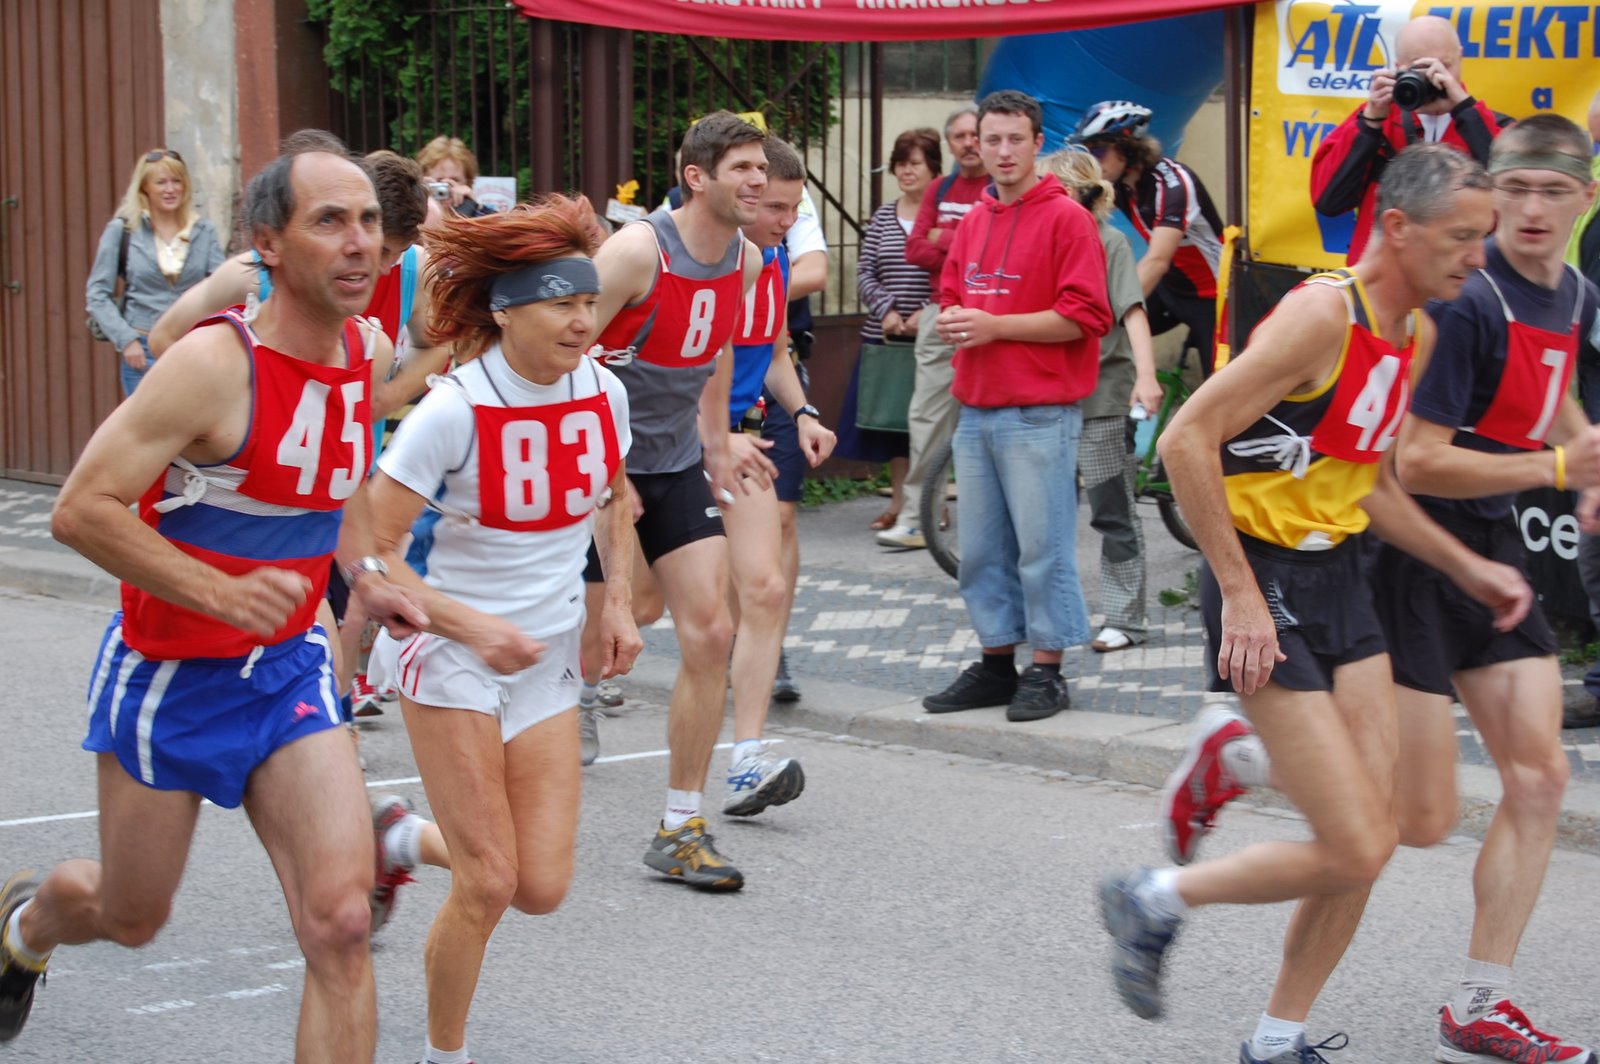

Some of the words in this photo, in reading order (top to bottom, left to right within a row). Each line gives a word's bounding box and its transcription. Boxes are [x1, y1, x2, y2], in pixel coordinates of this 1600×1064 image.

[1285, 5, 1385, 71] ATL
[1428, 6, 1600, 58] LEKT
[1531, 87, 1553, 109] a
[680, 288, 716, 358] 8
[277, 379, 366, 500] 45
[501, 410, 608, 522] 83
